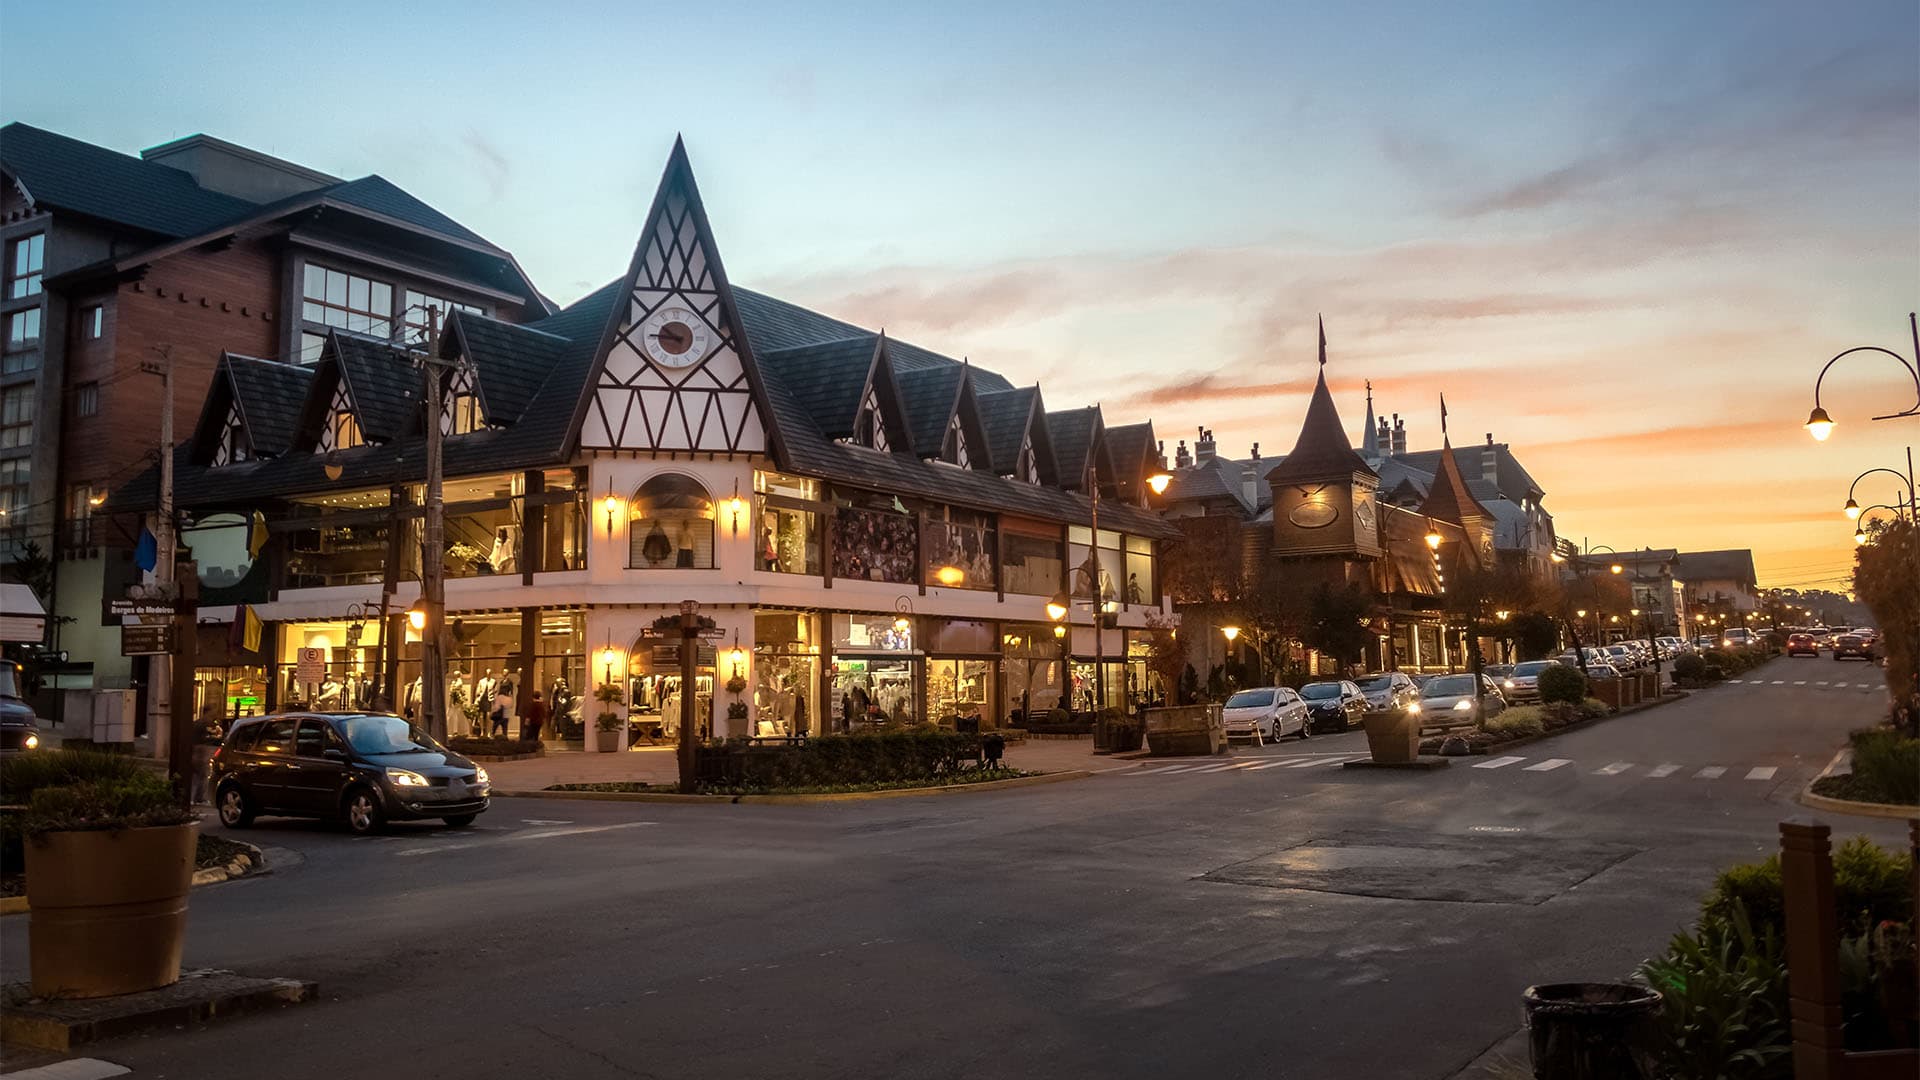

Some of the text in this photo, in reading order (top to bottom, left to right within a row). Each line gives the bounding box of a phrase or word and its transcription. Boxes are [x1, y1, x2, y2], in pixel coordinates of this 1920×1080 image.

[111, 606, 175, 615] Borges de Medeiros
[308, 650, 315, 660] E
